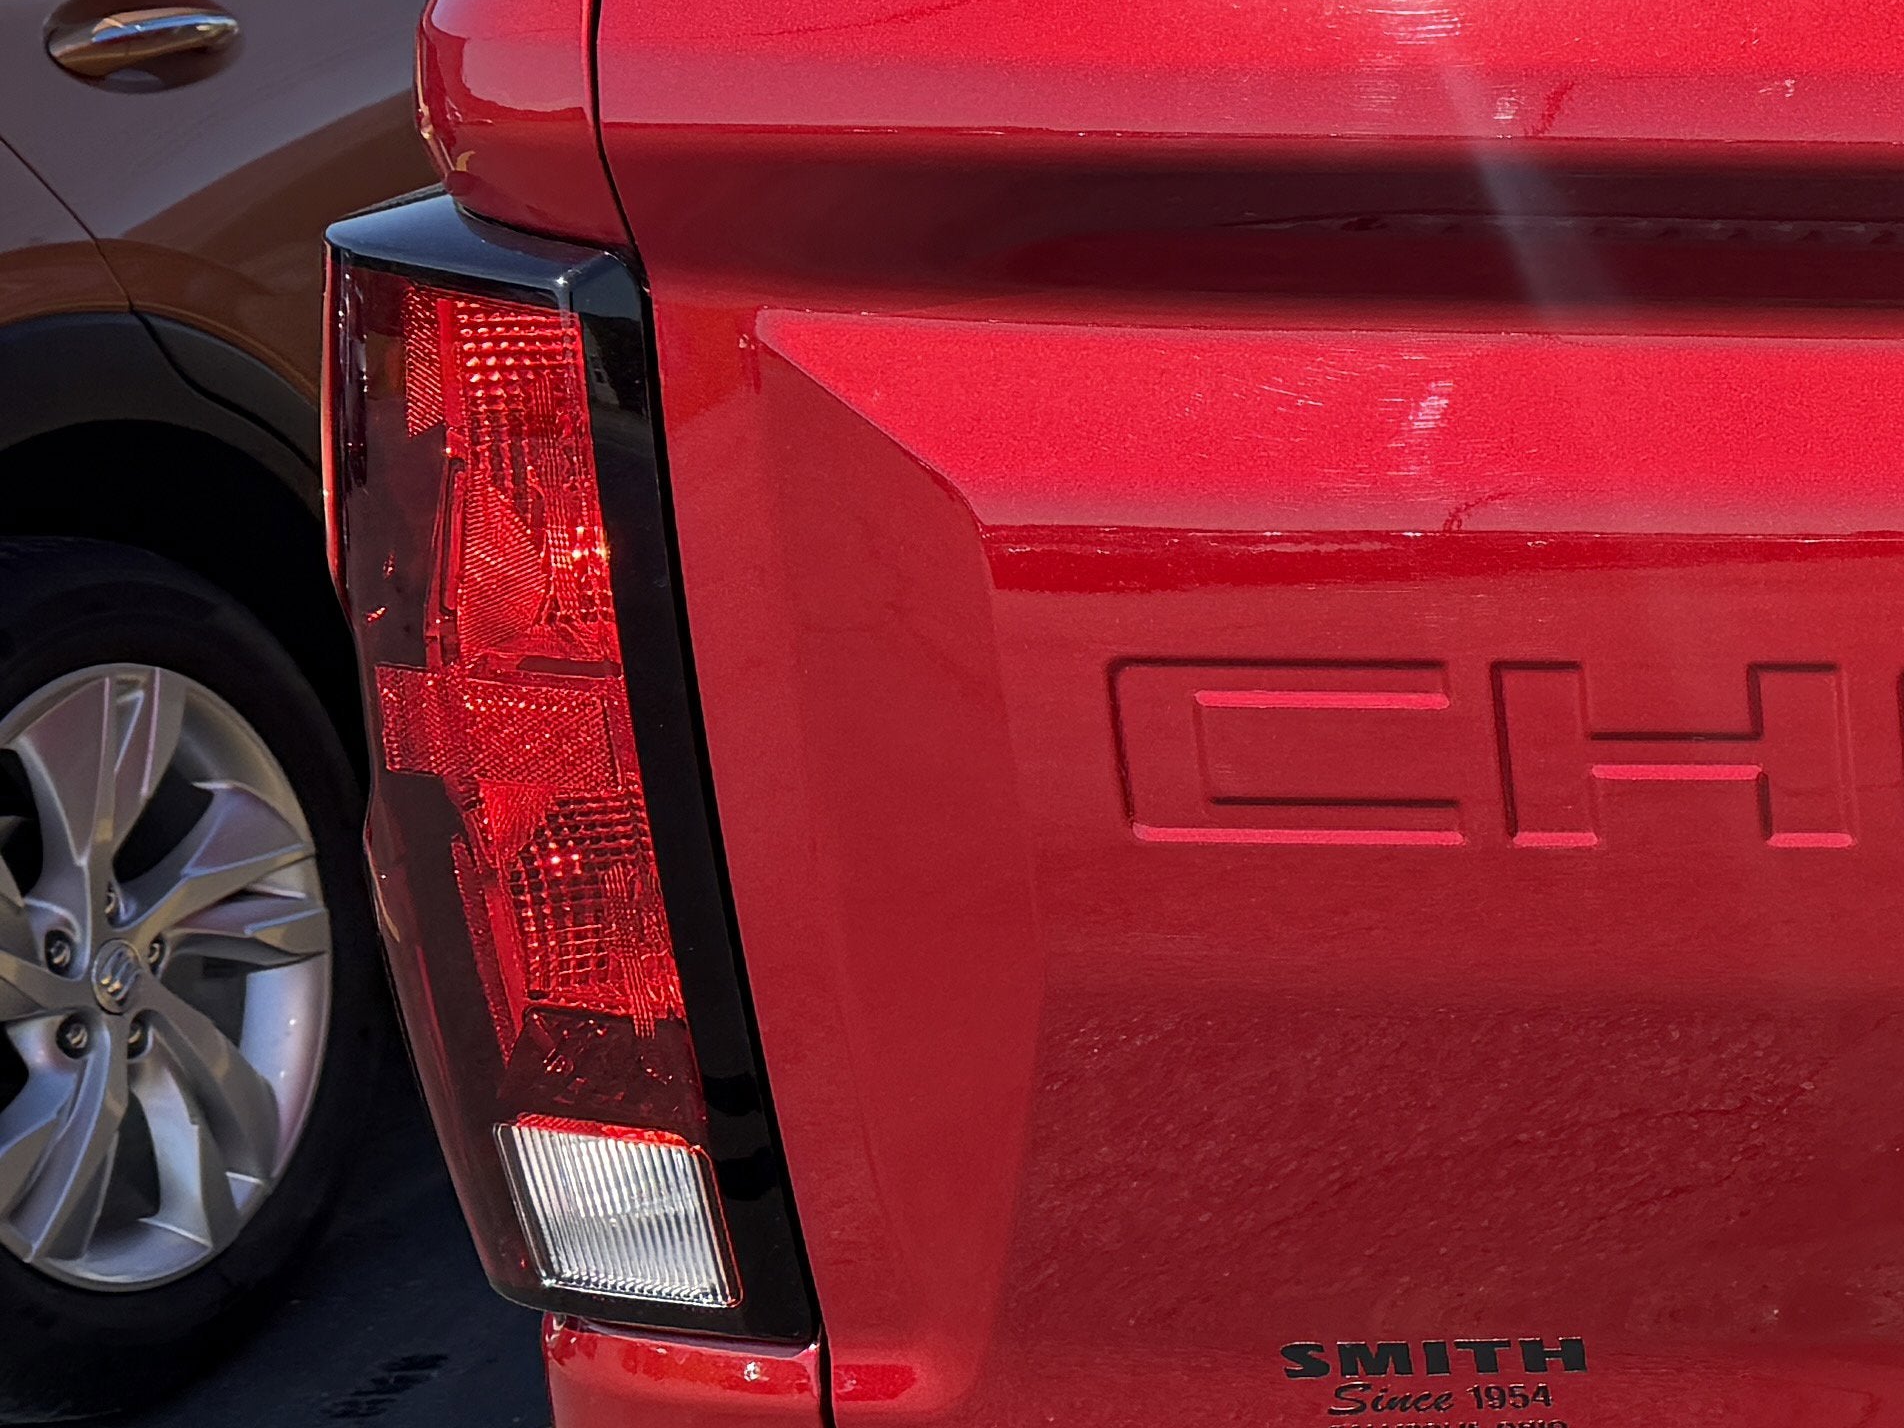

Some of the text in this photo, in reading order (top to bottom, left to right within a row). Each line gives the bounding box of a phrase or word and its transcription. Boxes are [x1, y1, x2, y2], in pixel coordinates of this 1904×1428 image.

[1280, 1336, 1589, 1380] SMITH
[1327, 1381, 1554, 1416] Since 1954
